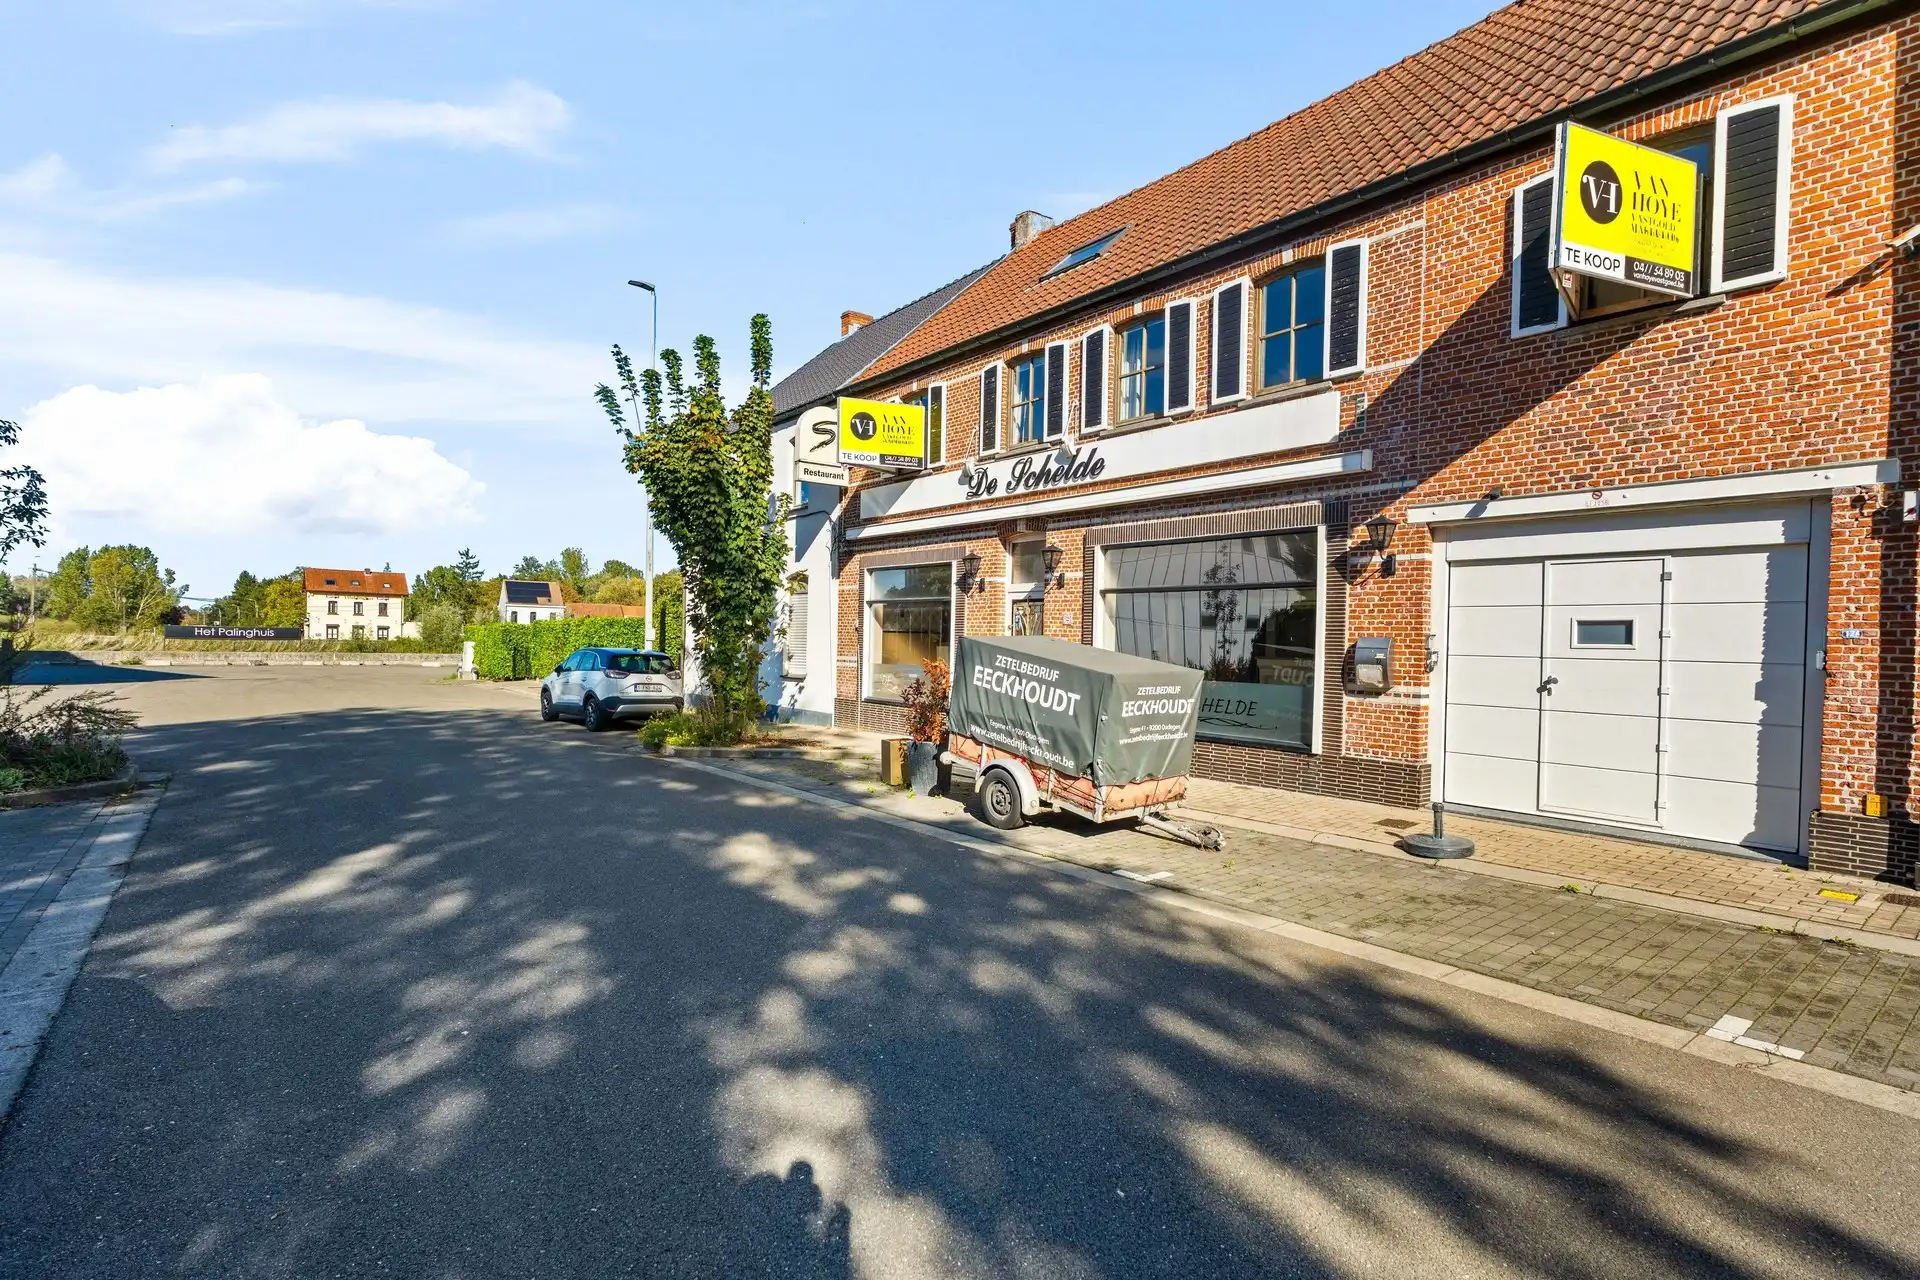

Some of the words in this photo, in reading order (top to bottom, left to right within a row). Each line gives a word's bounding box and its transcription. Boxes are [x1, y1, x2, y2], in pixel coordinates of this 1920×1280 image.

[1632, 191, 1682, 223] HOYE
[1565, 247, 1581, 264] TE
[1584, 251, 1621, 272] KOOP
[1653, 266, 1664, 277] 54
[1664, 268, 1674, 279] 89
[1675, 271, 1685, 282] 03
[842, 452, 852, 460] TE
[854, 453, 877, 462] KOOP
[803, 467, 844, 480] Restaurant
[966, 467, 998, 499] De
[1006, 447, 1106, 493] Schelde
[194, 627, 216, 636] Het
[218, 627, 275, 639] Palinghuis
[995, 654, 1059, 682] ZETELBEDRIJF
[973, 664, 1080, 716] EECKHOUDT
[1136, 685, 1181, 696] ZETELBEDRIJF
[1121, 698, 1195, 717] EECKHOUDT
[1199, 697, 1258, 716] HELDE
